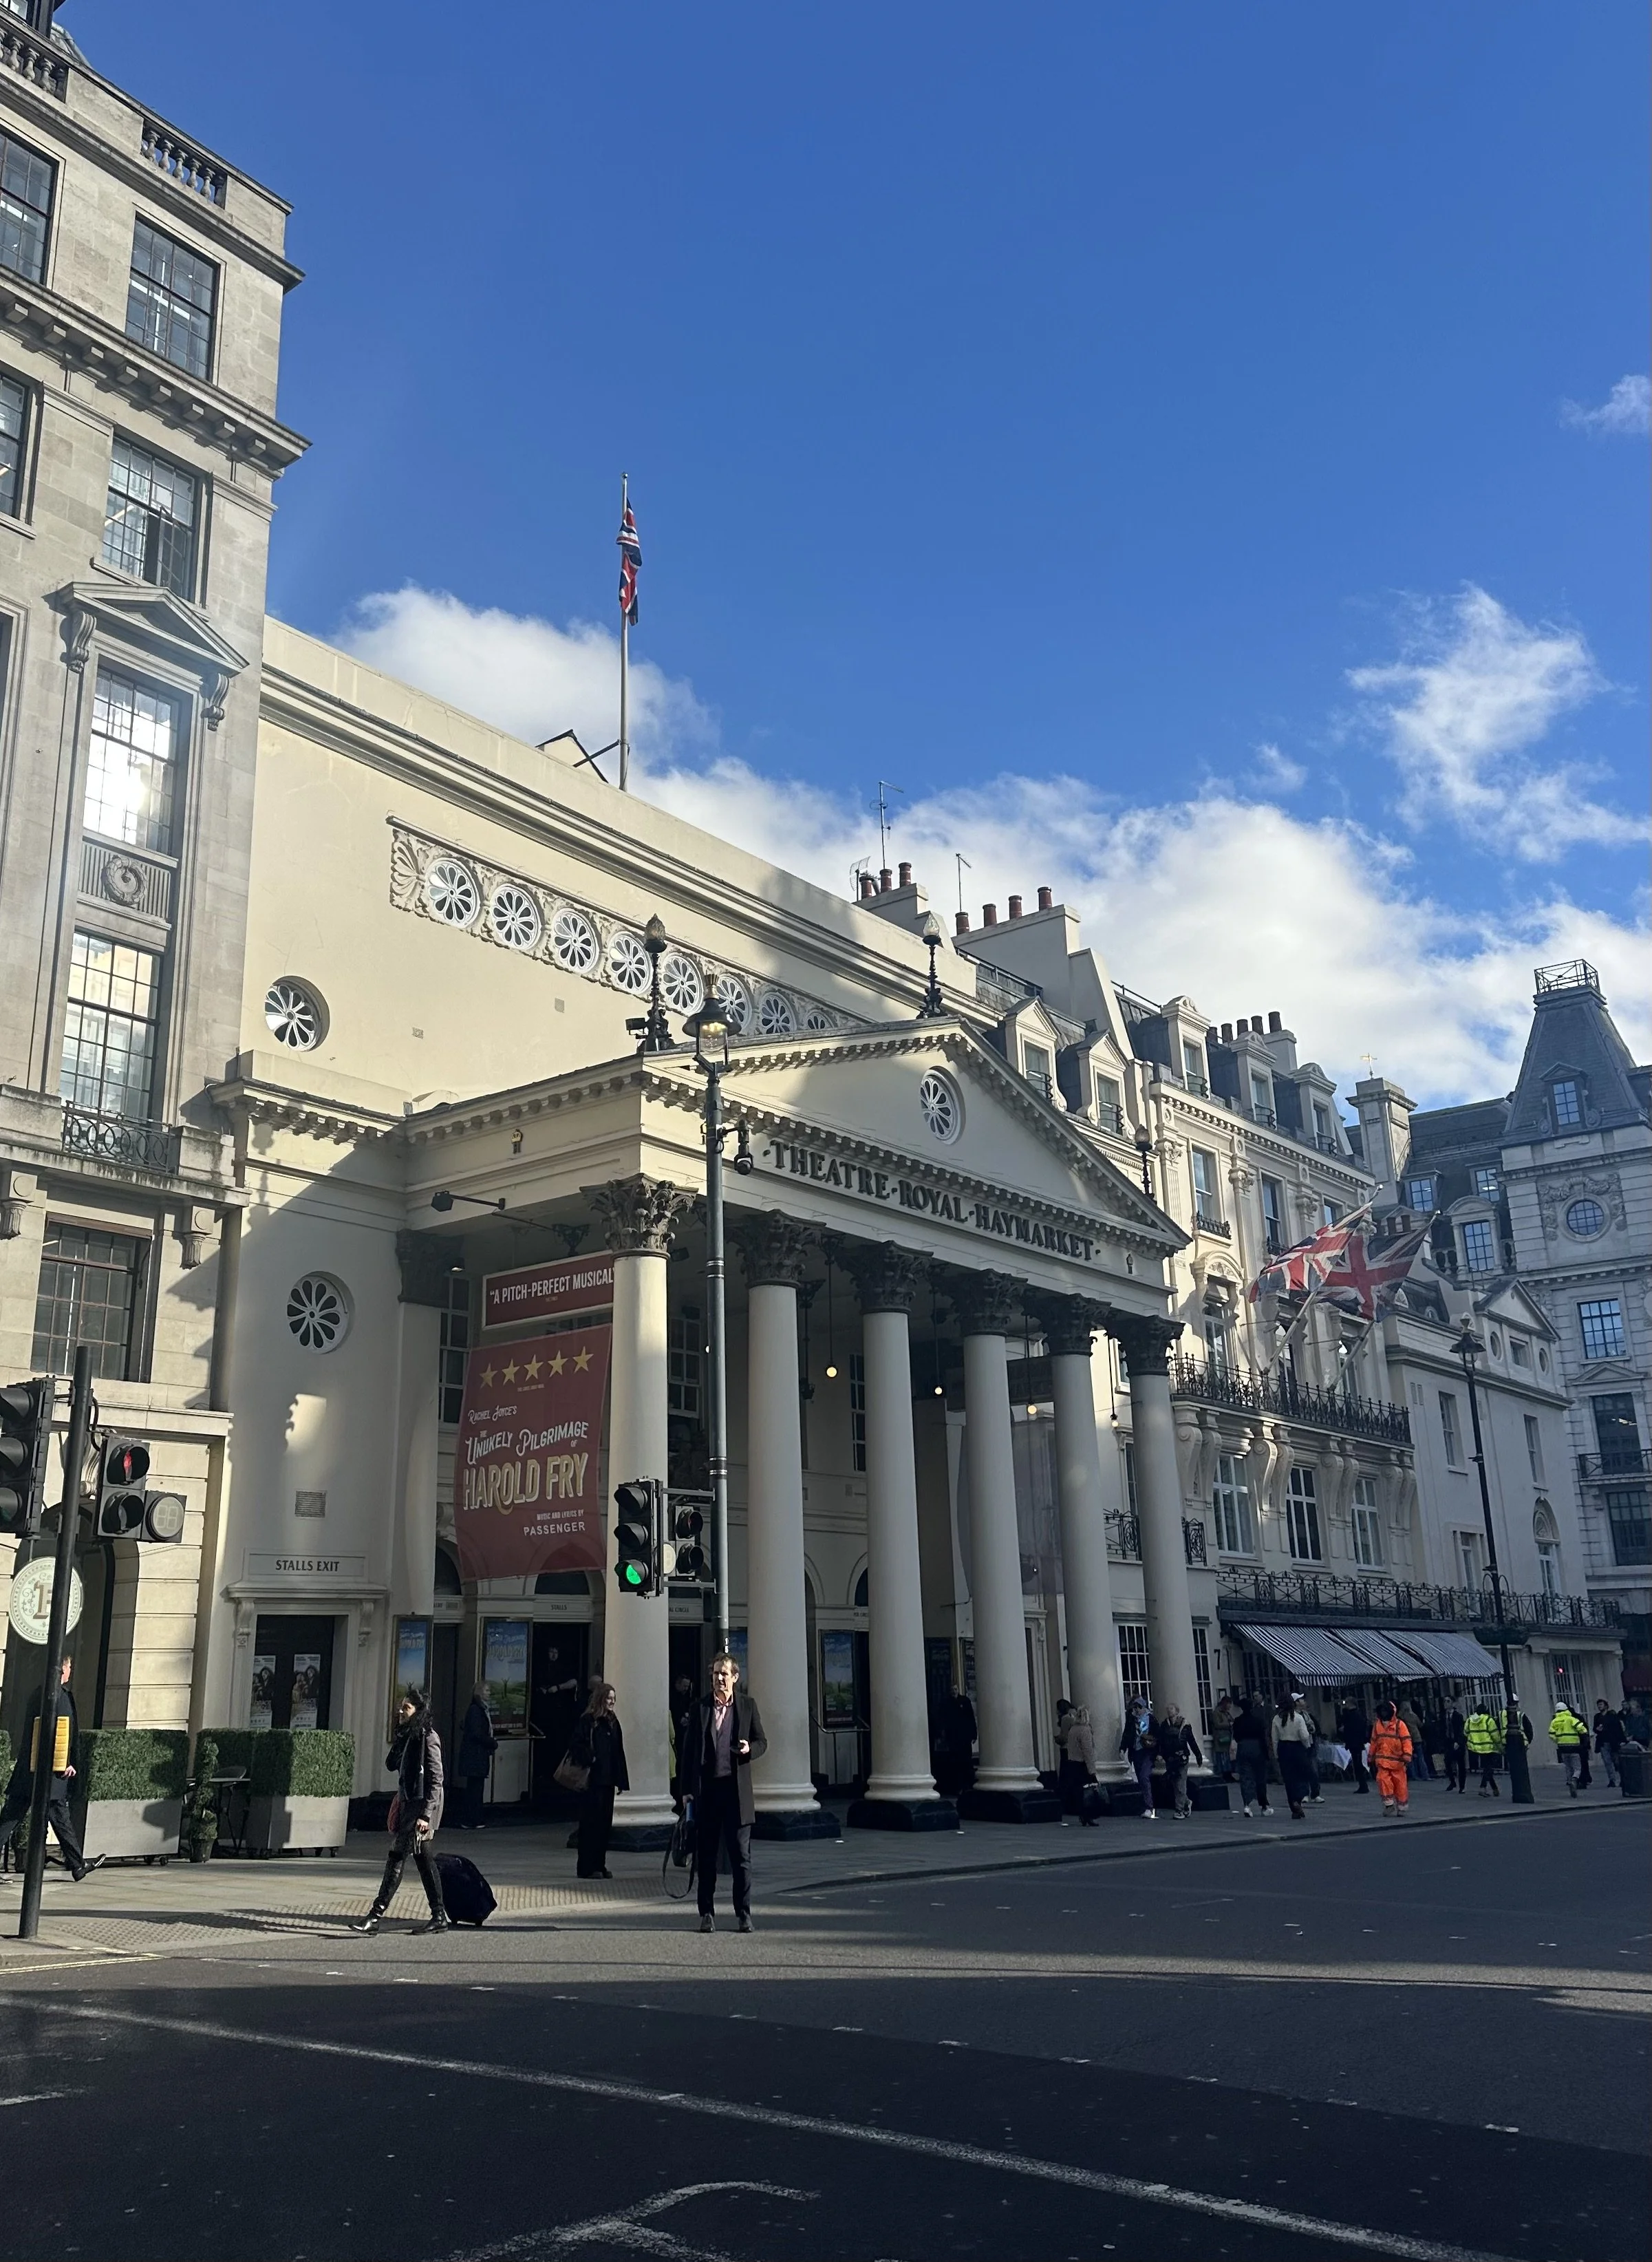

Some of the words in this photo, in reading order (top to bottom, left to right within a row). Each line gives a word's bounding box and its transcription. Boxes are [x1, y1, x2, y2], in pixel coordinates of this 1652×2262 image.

[770, 1140, 890, 1200] THEATRE
[899, 1180, 967, 1223] ROYAL
[975, 1204, 1094, 1261] HAYMARKET
[502, 1275, 570, 1303] PITCH-PERFECT
[464, 1431, 513, 1465] UNLIKELY
[515, 1420, 589, 1457] PILGRIMAGE
[463, 1458, 540, 1515] HAROLD
[546, 1452, 588, 1500] FRY
[524, 1522, 586, 1537] PASSENGER
[275, 1559, 313, 1572] STALLS
[317, 1561, 340, 1572] EXIT
[1214, 1649, 1221, 1670] 7
